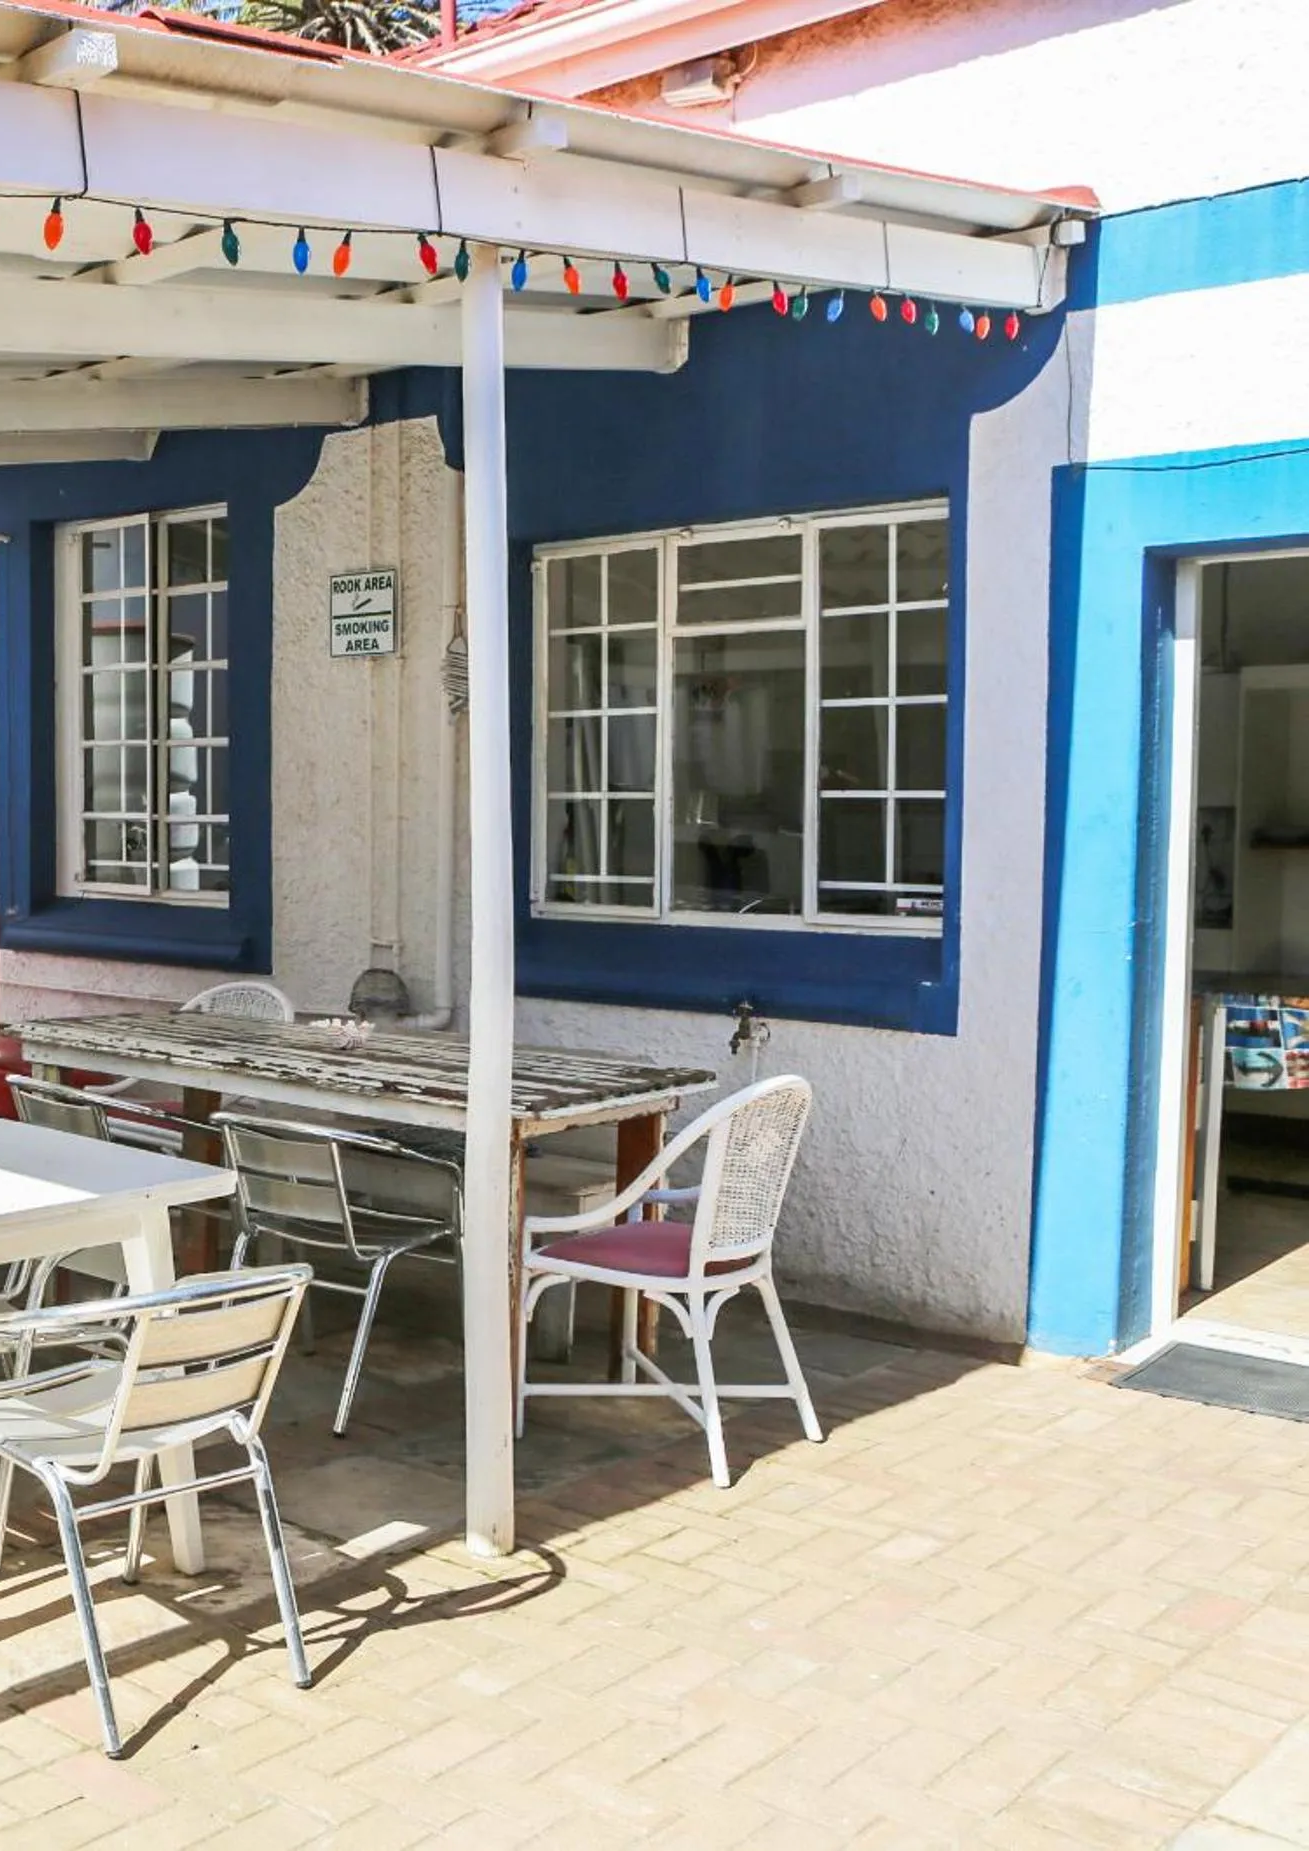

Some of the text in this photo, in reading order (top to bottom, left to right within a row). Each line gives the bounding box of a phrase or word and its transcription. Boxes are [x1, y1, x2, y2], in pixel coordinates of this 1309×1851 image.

[333, 576, 393, 594] ROOK AREA
[334, 619, 390, 636] SMOKING
[345, 638, 380, 652] AREA
